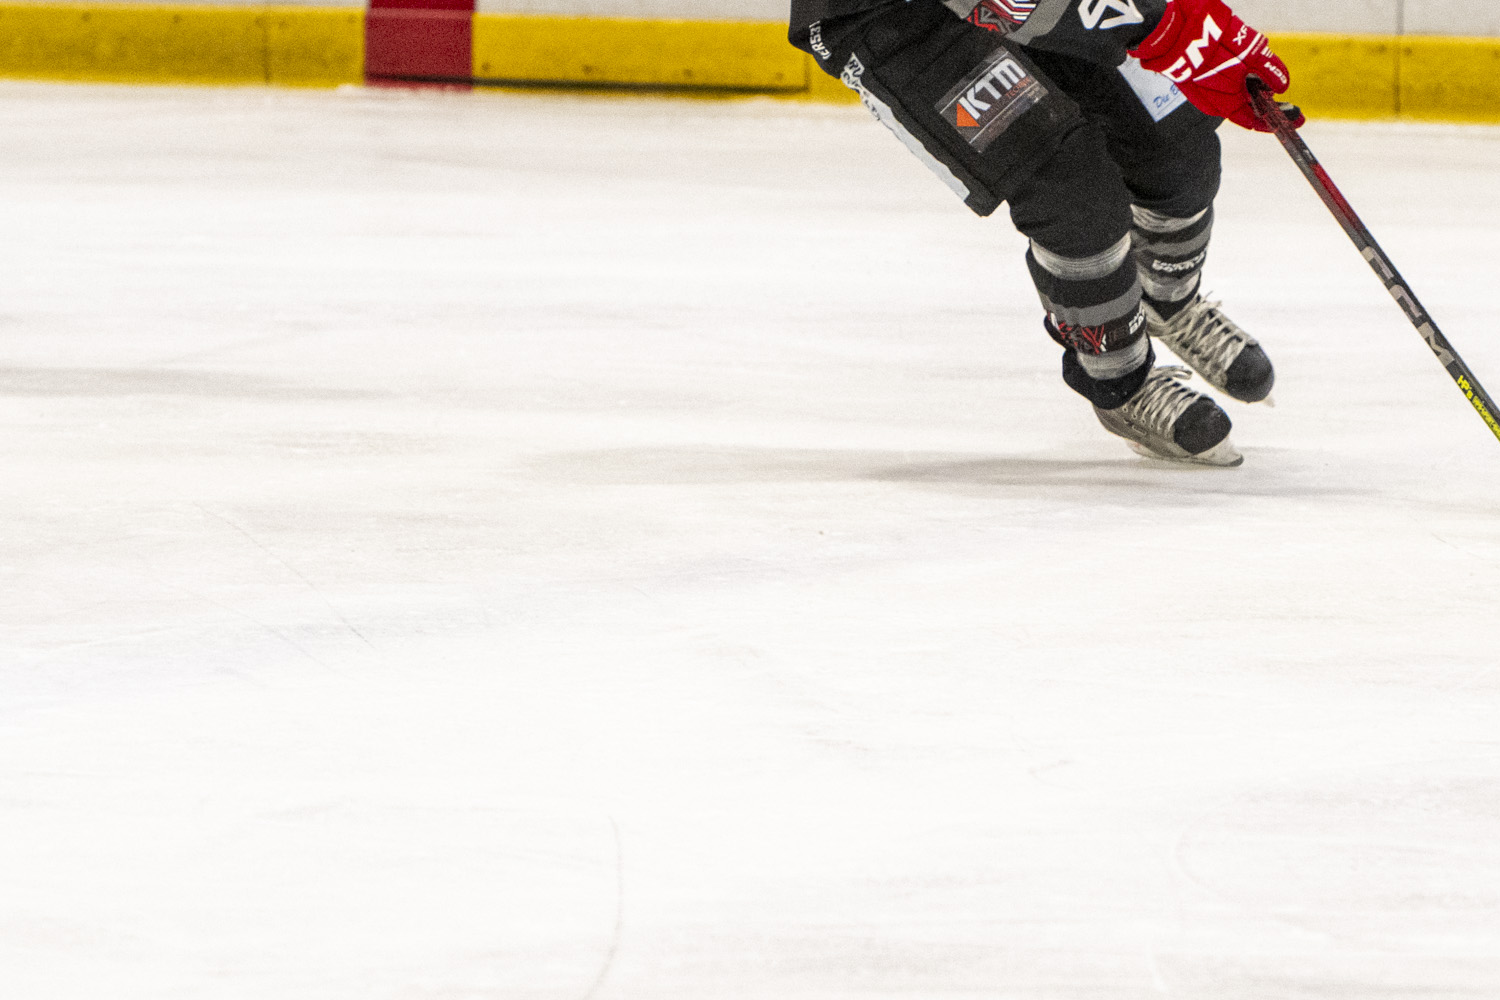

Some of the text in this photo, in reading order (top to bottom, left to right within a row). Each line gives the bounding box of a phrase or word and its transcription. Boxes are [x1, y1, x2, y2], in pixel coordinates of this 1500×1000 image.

[958, 58, 1026, 120] KTM
[1264, 61, 1287, 85] CCM
[1360, 246, 1455, 369] CCM
